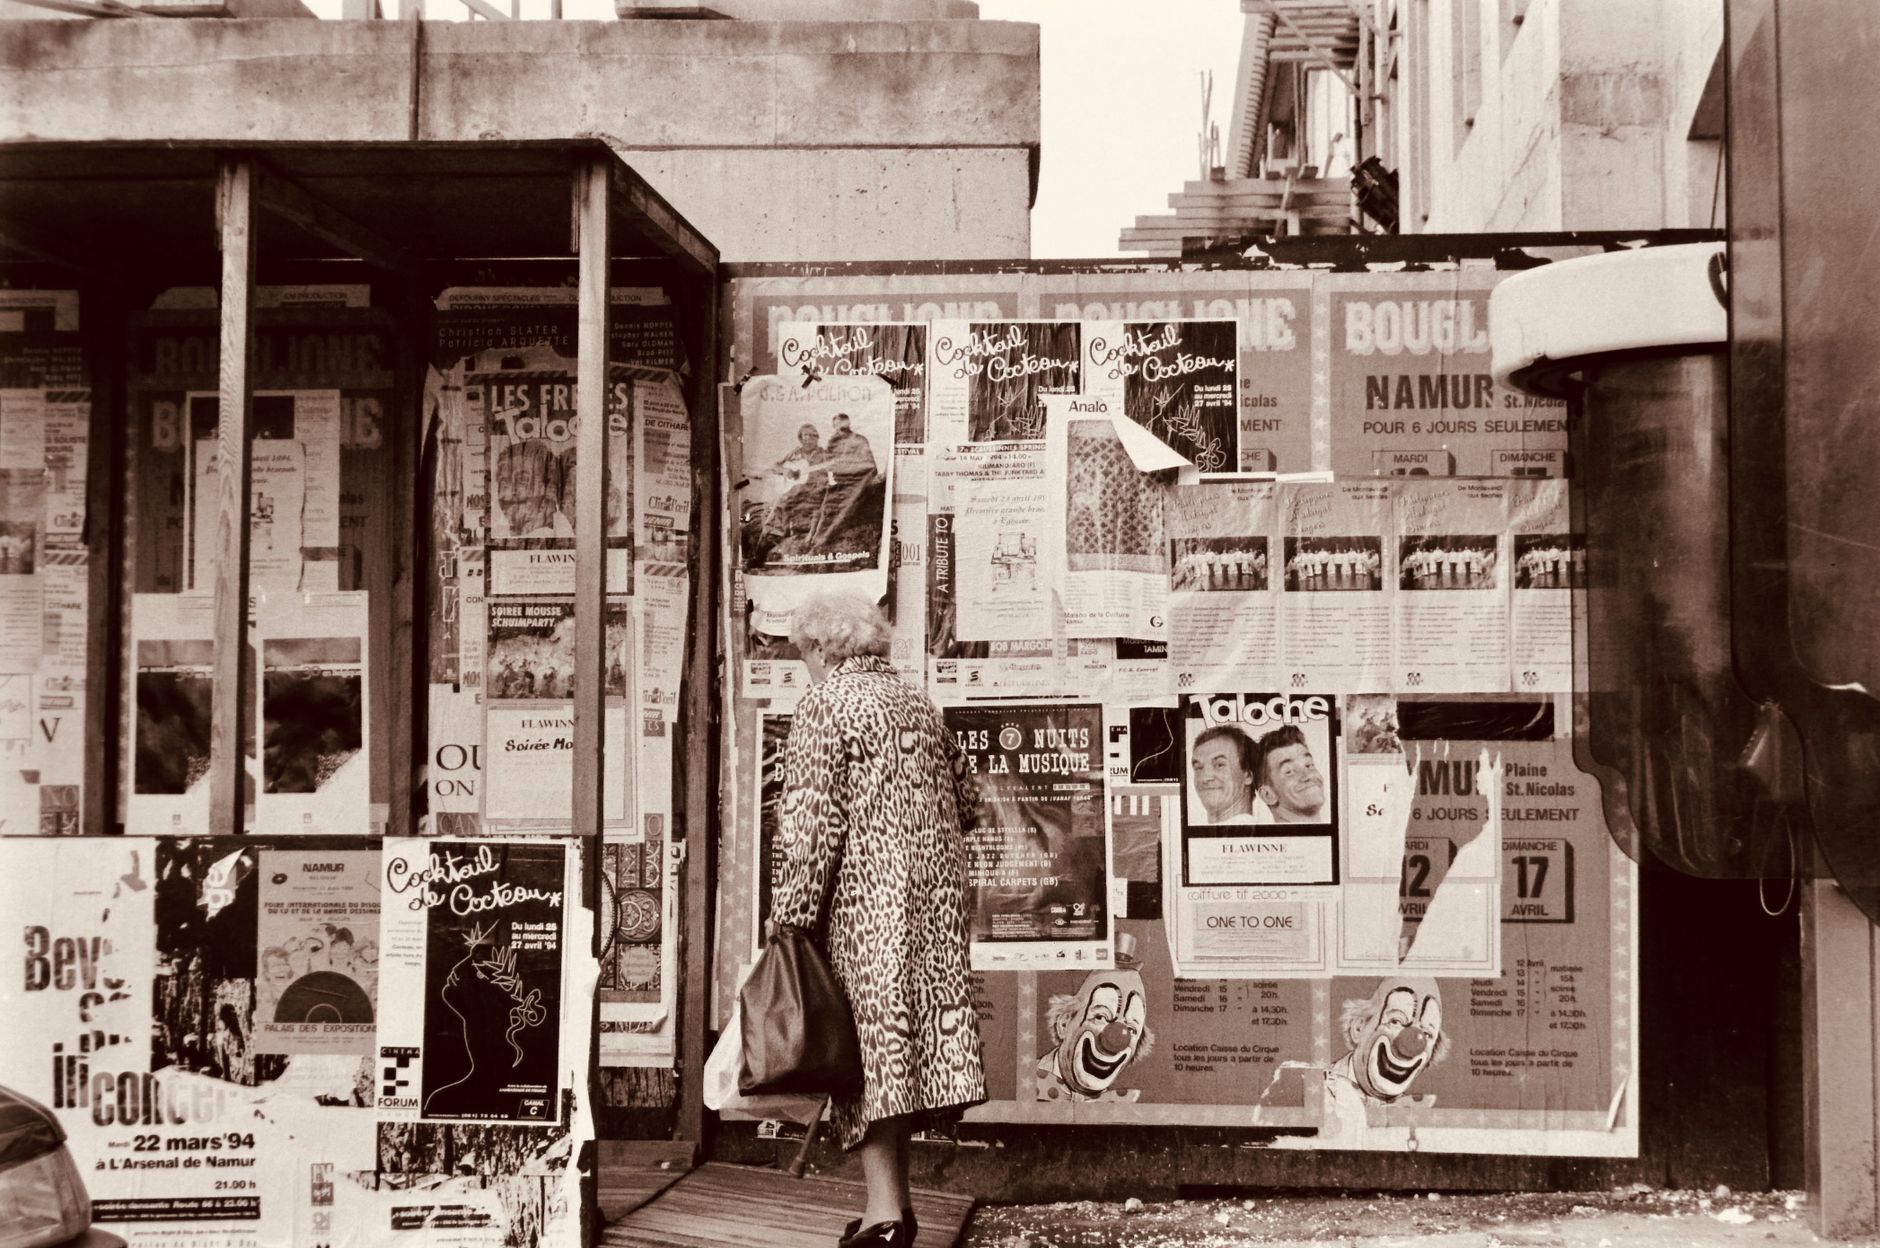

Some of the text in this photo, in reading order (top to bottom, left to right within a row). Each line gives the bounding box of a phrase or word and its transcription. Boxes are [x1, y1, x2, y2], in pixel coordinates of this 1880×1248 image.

[510, 325, 558, 335] SLATER
[1345, 299, 1491, 356] BOUGL
[782, 327, 874, 367] Cocktail
[935, 325, 1028, 365] Cocktail
[1089, 324, 1183, 366] Cocktail
[953, 360, 983, 379] de
[1107, 360, 1138, 380] de
[1366, 374, 1493, 410] NAMUR
[491, 384, 530, 413] LES
[1240, 394, 1278, 408] icolas
[495, 404, 629, 446] Taloe
[1363, 421, 1405, 434] POUR
[1412, 421, 1422, 434] 6
[1426, 421, 1477, 434] JOURS
[1393, 454, 1429, 464] MARDI
[1499, 453, 1556, 463] DIMANCHE
[529, 554, 576, 564] FLAWIN
[783, 553, 825, 563] Spirituals
[835, 550, 870, 561] Gospels
[935, 517, 949, 593] A TRIBUTE TO
[491, 606, 561, 617] SOIREE MOUSSE
[491, 617, 556, 629] SCHUIMPARTY
[956, 729, 989, 749] LES
[1033, 728, 1090, 750] NUITS
[505, 738, 549, 752] Soirée
[988, 754, 1009, 774] LA
[1018, 753, 1090, 776] MUSIQUE
[1504, 762, 1548, 777] Plaine
[1412, 808, 1422, 821] 6
[1426, 808, 1478, 821] JOURS
[1222, 844, 1288, 853] FLAWINNE
[1404, 841, 1430, 851] ARDI
[1501, 841, 1558, 851] DIMANCHE
[303, 863, 345, 873] NAMUR
[386, 844, 500, 893] Cocktail
[995, 860, 1038, 868] JUDGEMENT
[969, 878, 997, 887] SPIRAL
[1000, 877, 1037, 887] CARPETS
[1511, 855, 1549, 899] 17
[408, 886, 446, 911] de
[1252, 890, 1288, 900] 2000
[1401, 904, 1428, 916] VRIL
[1511, 904, 1549, 916] AVRIL
[511, 922, 523, 931] Du
[524, 921, 544, 931] lundi
[1207, 916, 1293, 928] ONE TO ONE
[522, 931, 558, 941] mercredi
[511, 940, 522, 949] 27
[524, 940, 542, 950] avril
[1173, 985, 1210, 993] Vendredi
[1219, 985, 1228, 993] 15
[1470, 989, 1507, 997] Vendredi
[1173, 994, 1206, 1003] Samedi
[1470, 998, 1503, 1006] Samedi
[1173, 1003, 1228, 1012] Dimanche 17
[1470, 1008, 1512, 1017] Dimanche
[264, 1024, 295, 1033] PALAIS
[299, 1024, 318, 1033] DES
[381, 1048, 420, 1056] CINEMA
[1173, 1043, 1280, 1054] Location Caisse du Cirque
[1470, 1048, 1506, 1057] Location
[1538, 1049, 1549, 1057] du
[1207, 1054, 1228, 1063] jours
[1238, 1055, 1261, 1063] partir
[1174, 1063, 1184, 1071] 10
[378, 1097, 419, 1108] FORUM
[529, 1106, 538, 1115] C
[133, 1134, 160, 1151] 22
[96, 1155, 256, 1170] à L'Arsenal de Namur
[215, 1180, 256, 1190] 21.00 h
[172, 1200, 199, 1209] Route
